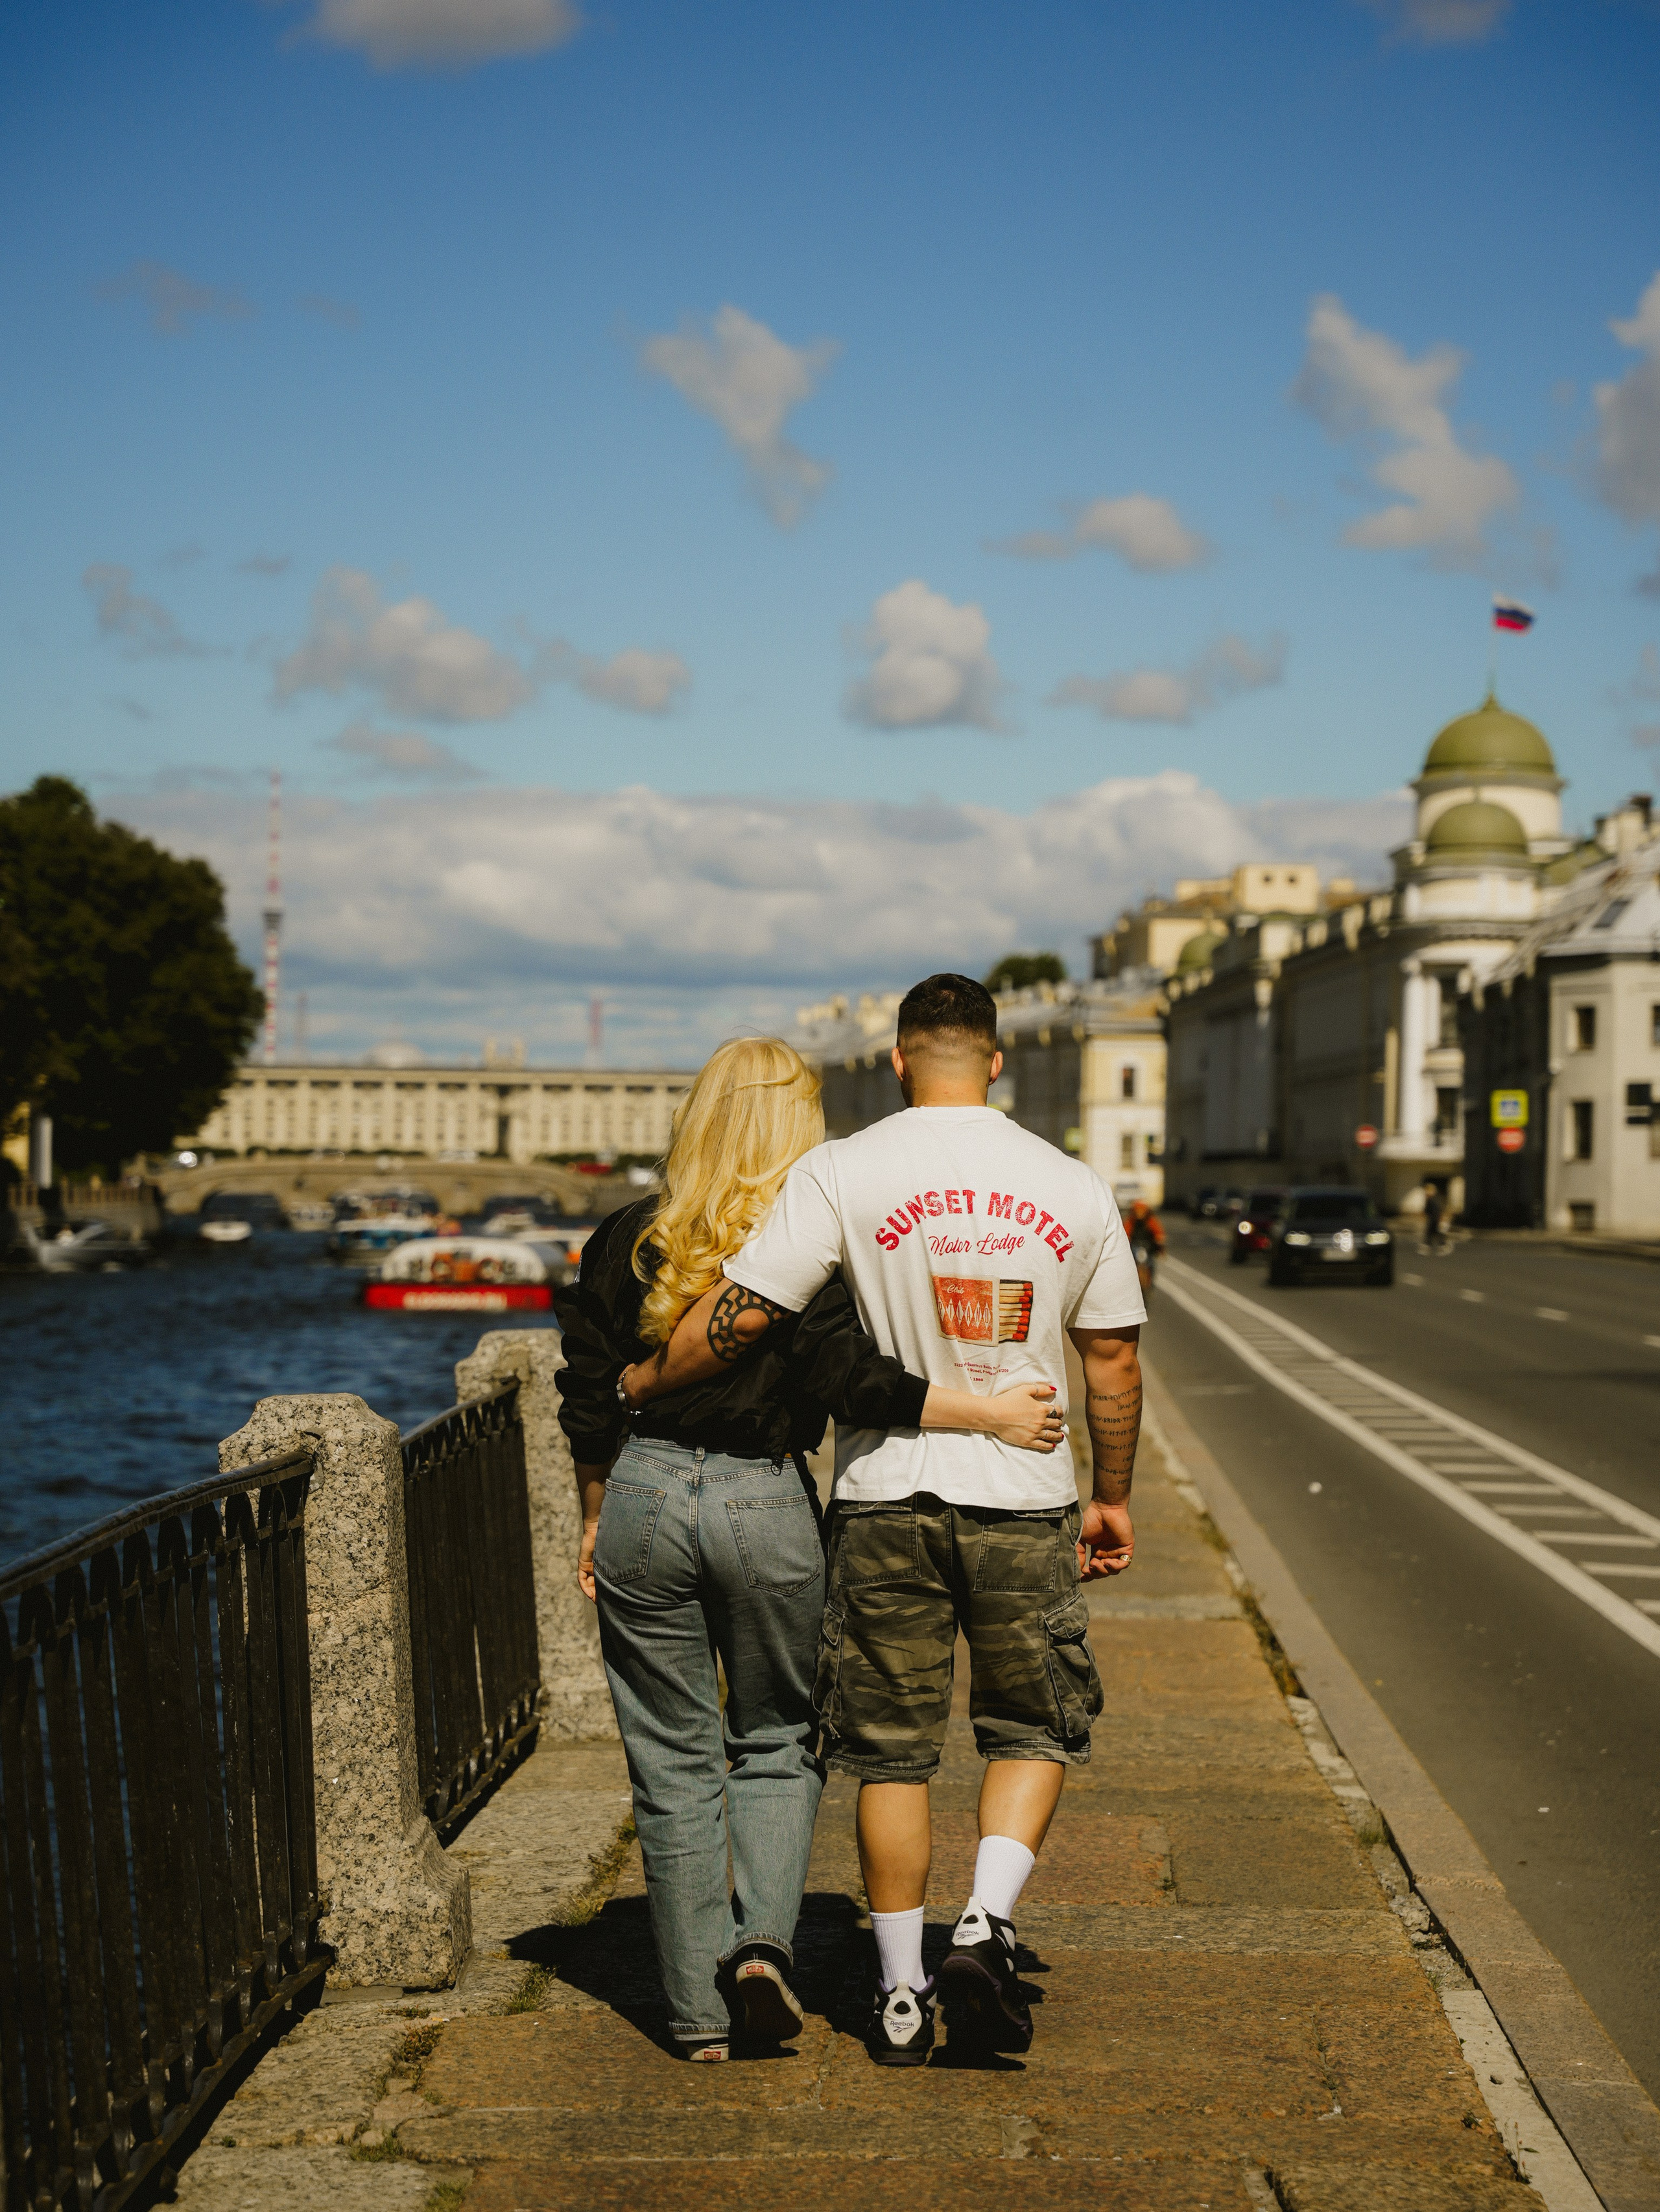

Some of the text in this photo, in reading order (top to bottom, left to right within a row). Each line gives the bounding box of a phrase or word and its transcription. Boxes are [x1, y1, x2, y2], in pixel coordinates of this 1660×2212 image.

[875, 1189, 1075, 1263] SUNSET MOTEL
[928, 1232, 1026, 1256] Motor Lodge
[947, 1283, 965, 1294] Club
